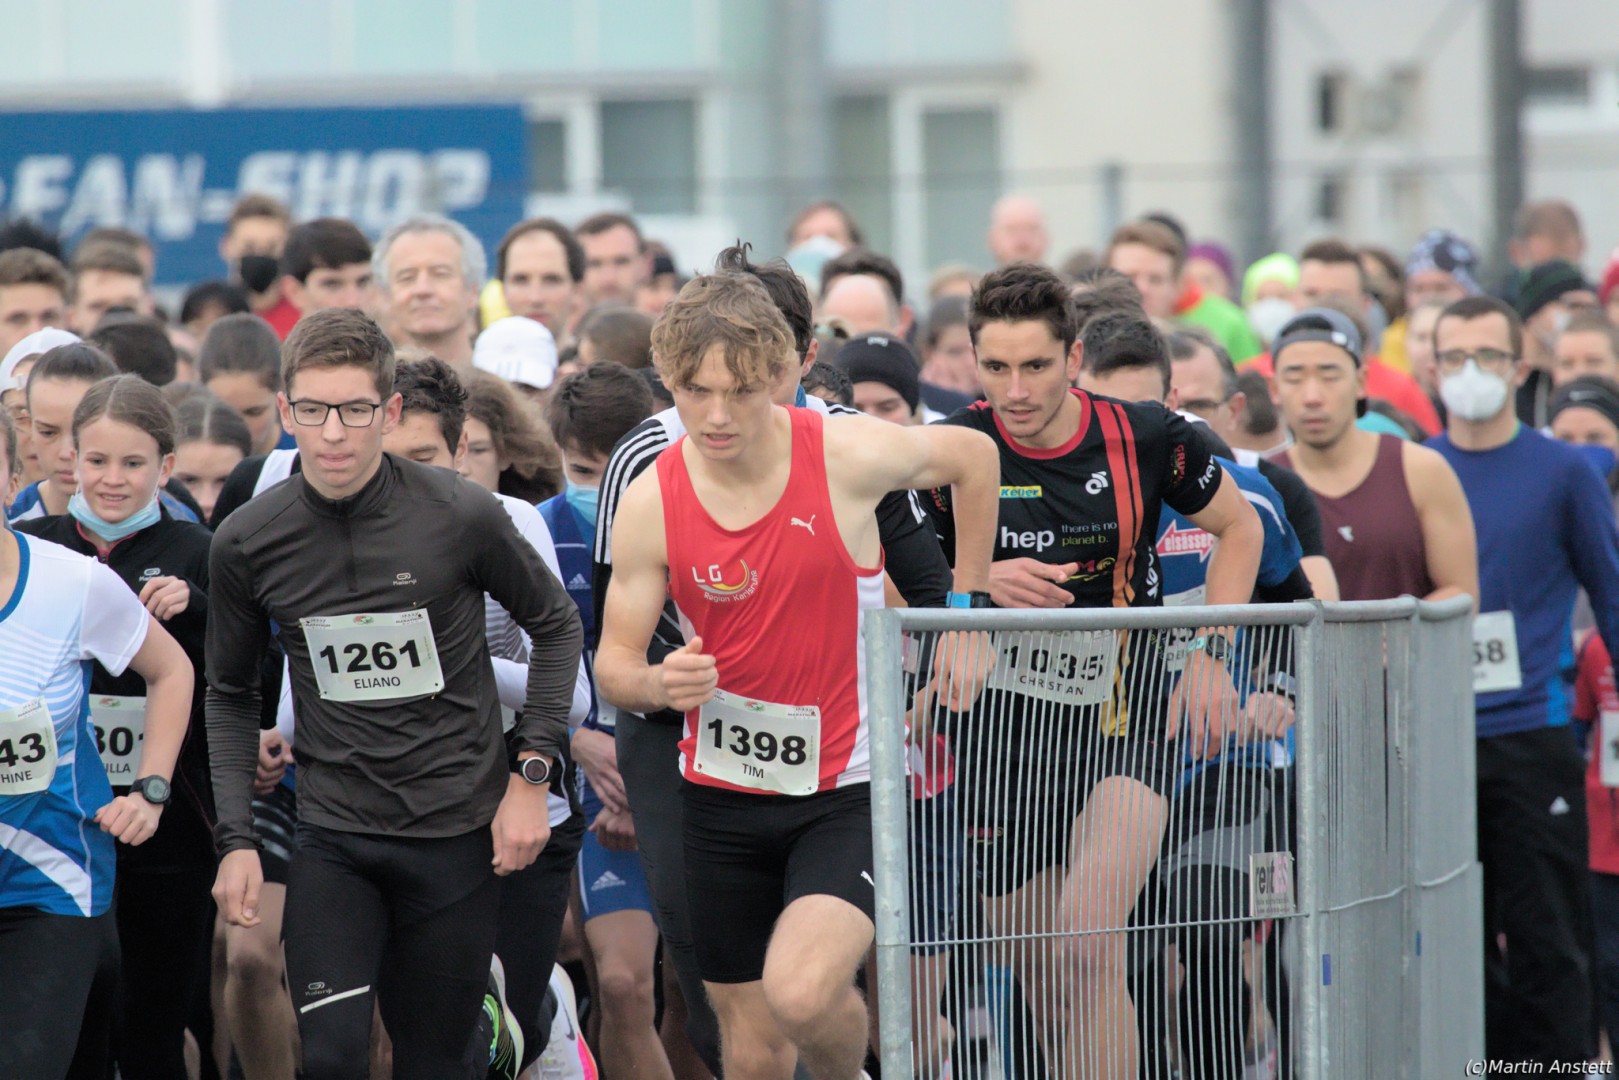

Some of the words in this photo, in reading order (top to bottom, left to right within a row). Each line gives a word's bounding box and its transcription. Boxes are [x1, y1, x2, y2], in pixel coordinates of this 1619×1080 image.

[1061, 524, 1090, 534] there
[1091, 522, 1101, 532] is
[1103, 521, 1118, 530] no
[1001, 526, 1055, 552] hep
[1062, 534, 1095, 547] planet
[1098, 534, 1109, 544] b.
[692, 564, 722, 583] LG
[733, 569, 759, 602] Karlsruhe
[704, 592, 730, 603] Region
[320, 639, 421, 674] 1261
[1003, 645, 1104, 681] 1035
[354, 676, 401, 689] ELIANO
[0, 733, 47, 768] 43
[708, 718, 806, 766] 1398
[1, 770, 33, 784] HINE
[742, 763, 764, 779] TIM
